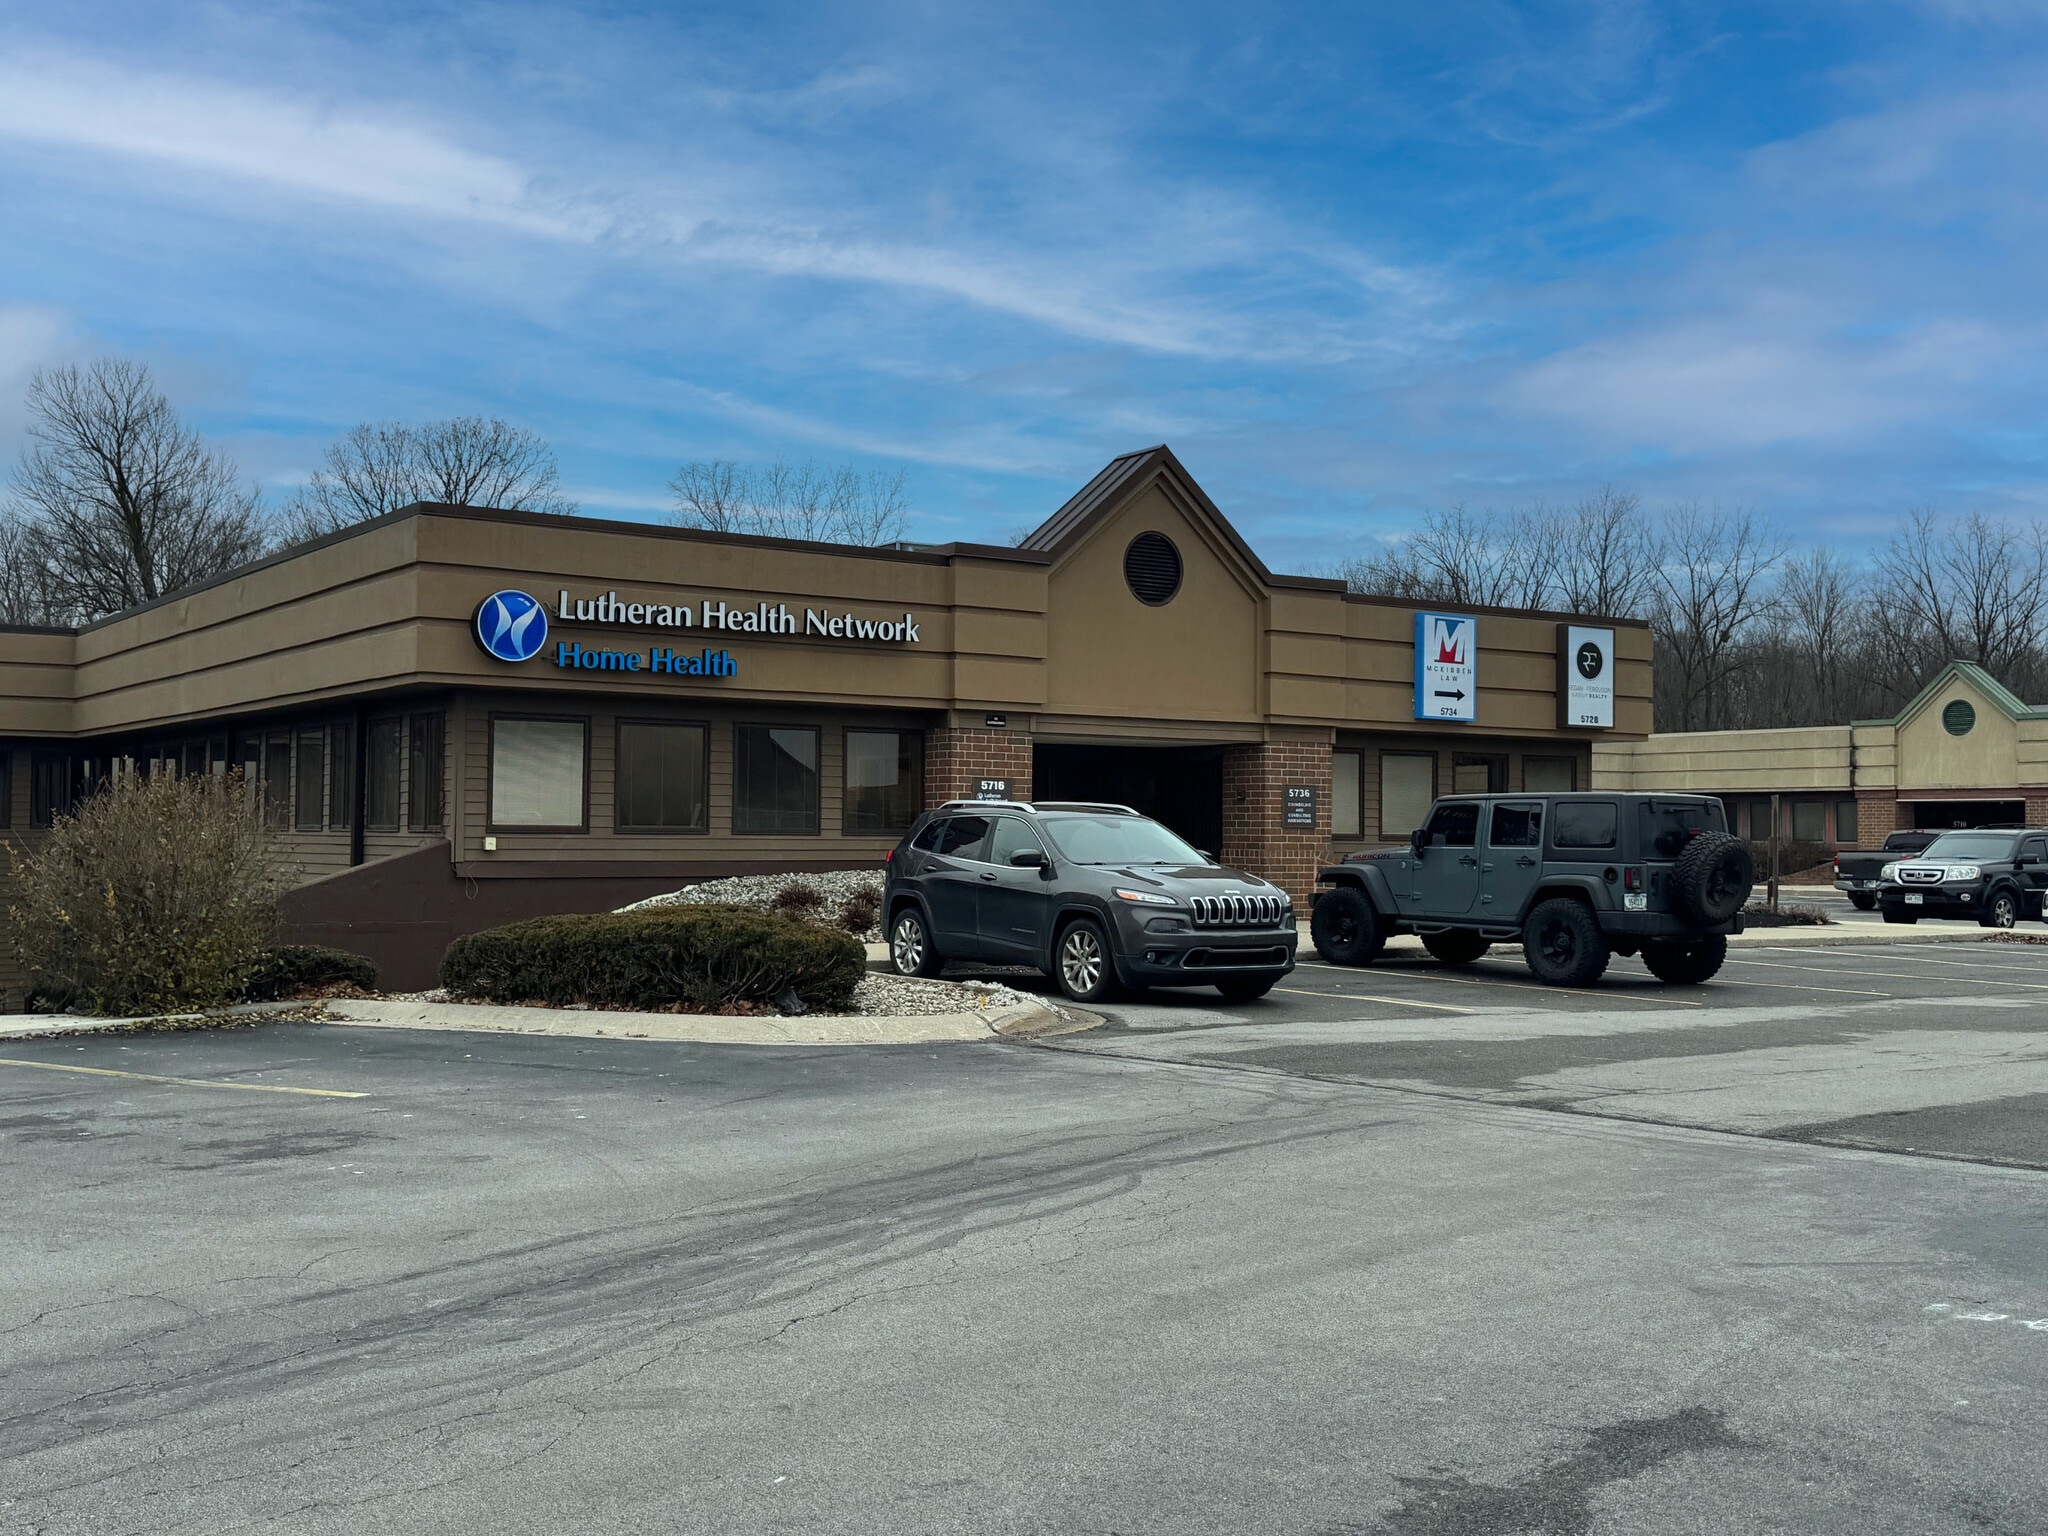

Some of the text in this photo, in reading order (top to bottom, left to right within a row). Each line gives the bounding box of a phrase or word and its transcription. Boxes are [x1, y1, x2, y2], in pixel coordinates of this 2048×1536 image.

[558, 590, 920, 642] Lutheran Health Network
[557, 642, 737, 676] Home Health
[1440, 707, 1457, 716] 5734
[1580, 715, 1599, 724] 5728
[980, 780, 1005, 790] 5716
[1288, 788, 1310, 798] 5736
[1953, 820, 1967, 828] 5710
